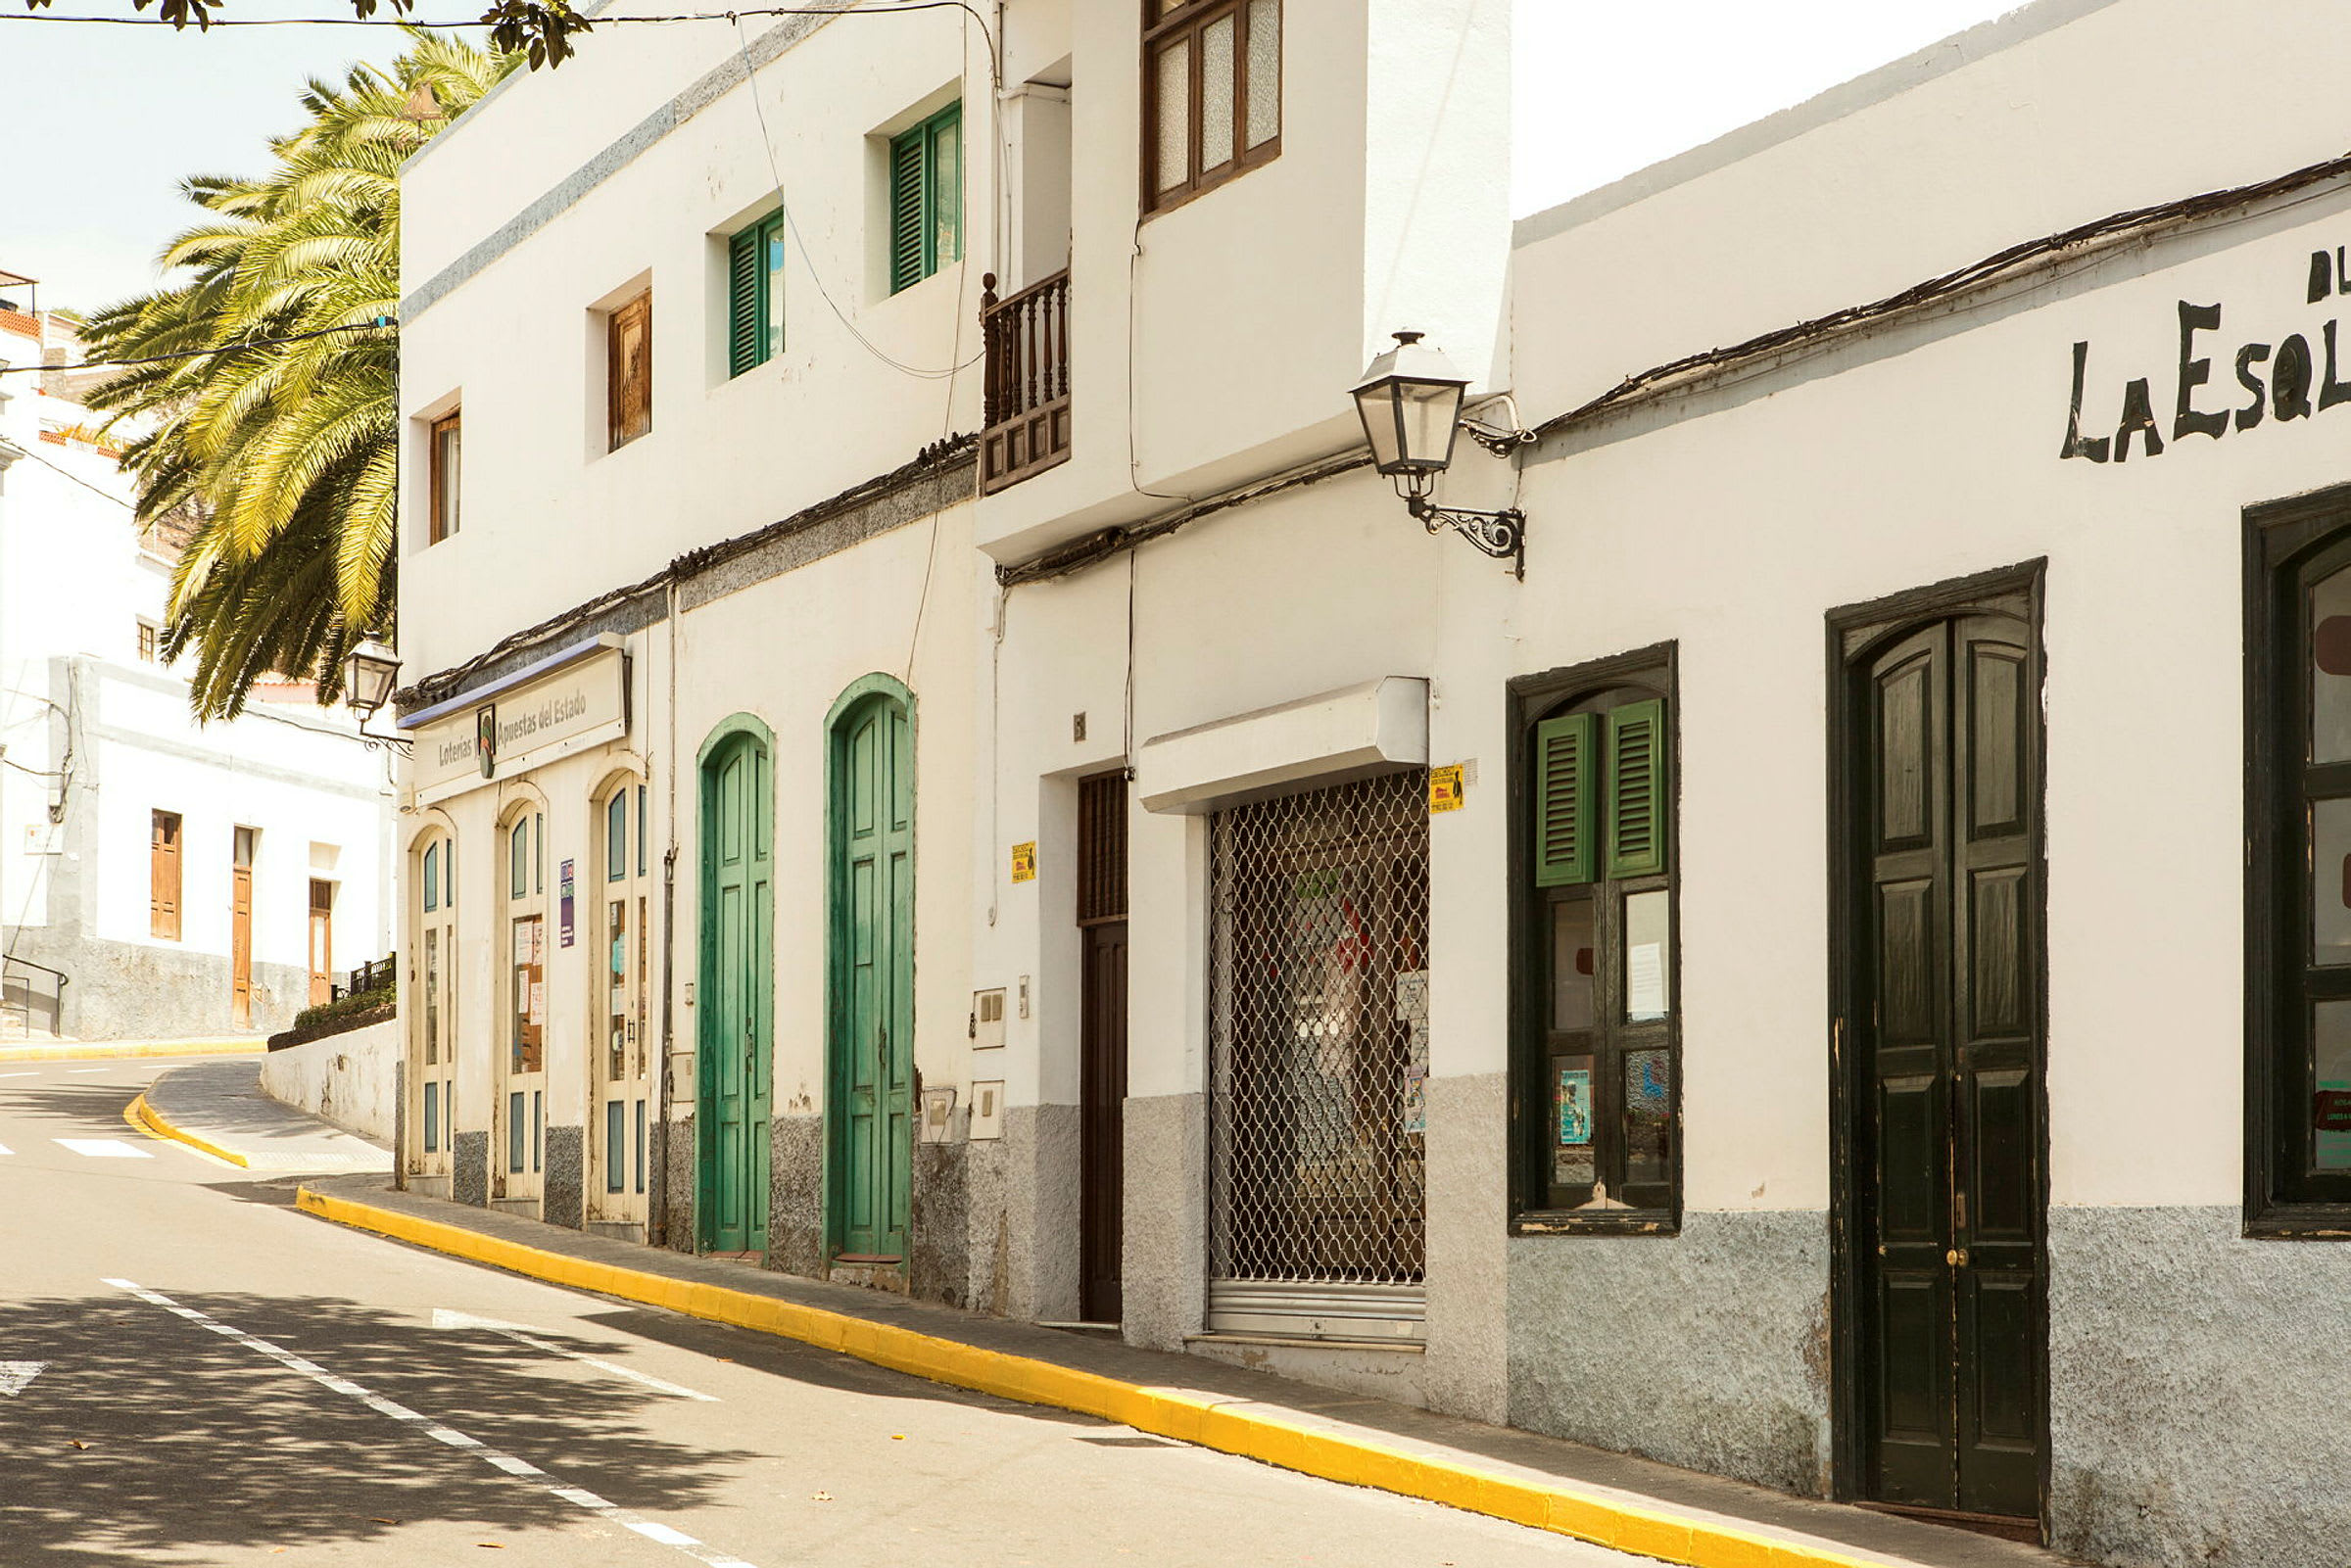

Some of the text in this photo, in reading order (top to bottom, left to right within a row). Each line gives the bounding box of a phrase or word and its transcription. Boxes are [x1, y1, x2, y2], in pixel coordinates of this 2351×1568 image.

[2060, 341, 2164, 463] LA
[439, 735, 471, 767] Loterías
[498, 716, 537, 748] Apuestas
[538, 699, 552, 730] del
[554, 689, 587, 723] Estado
